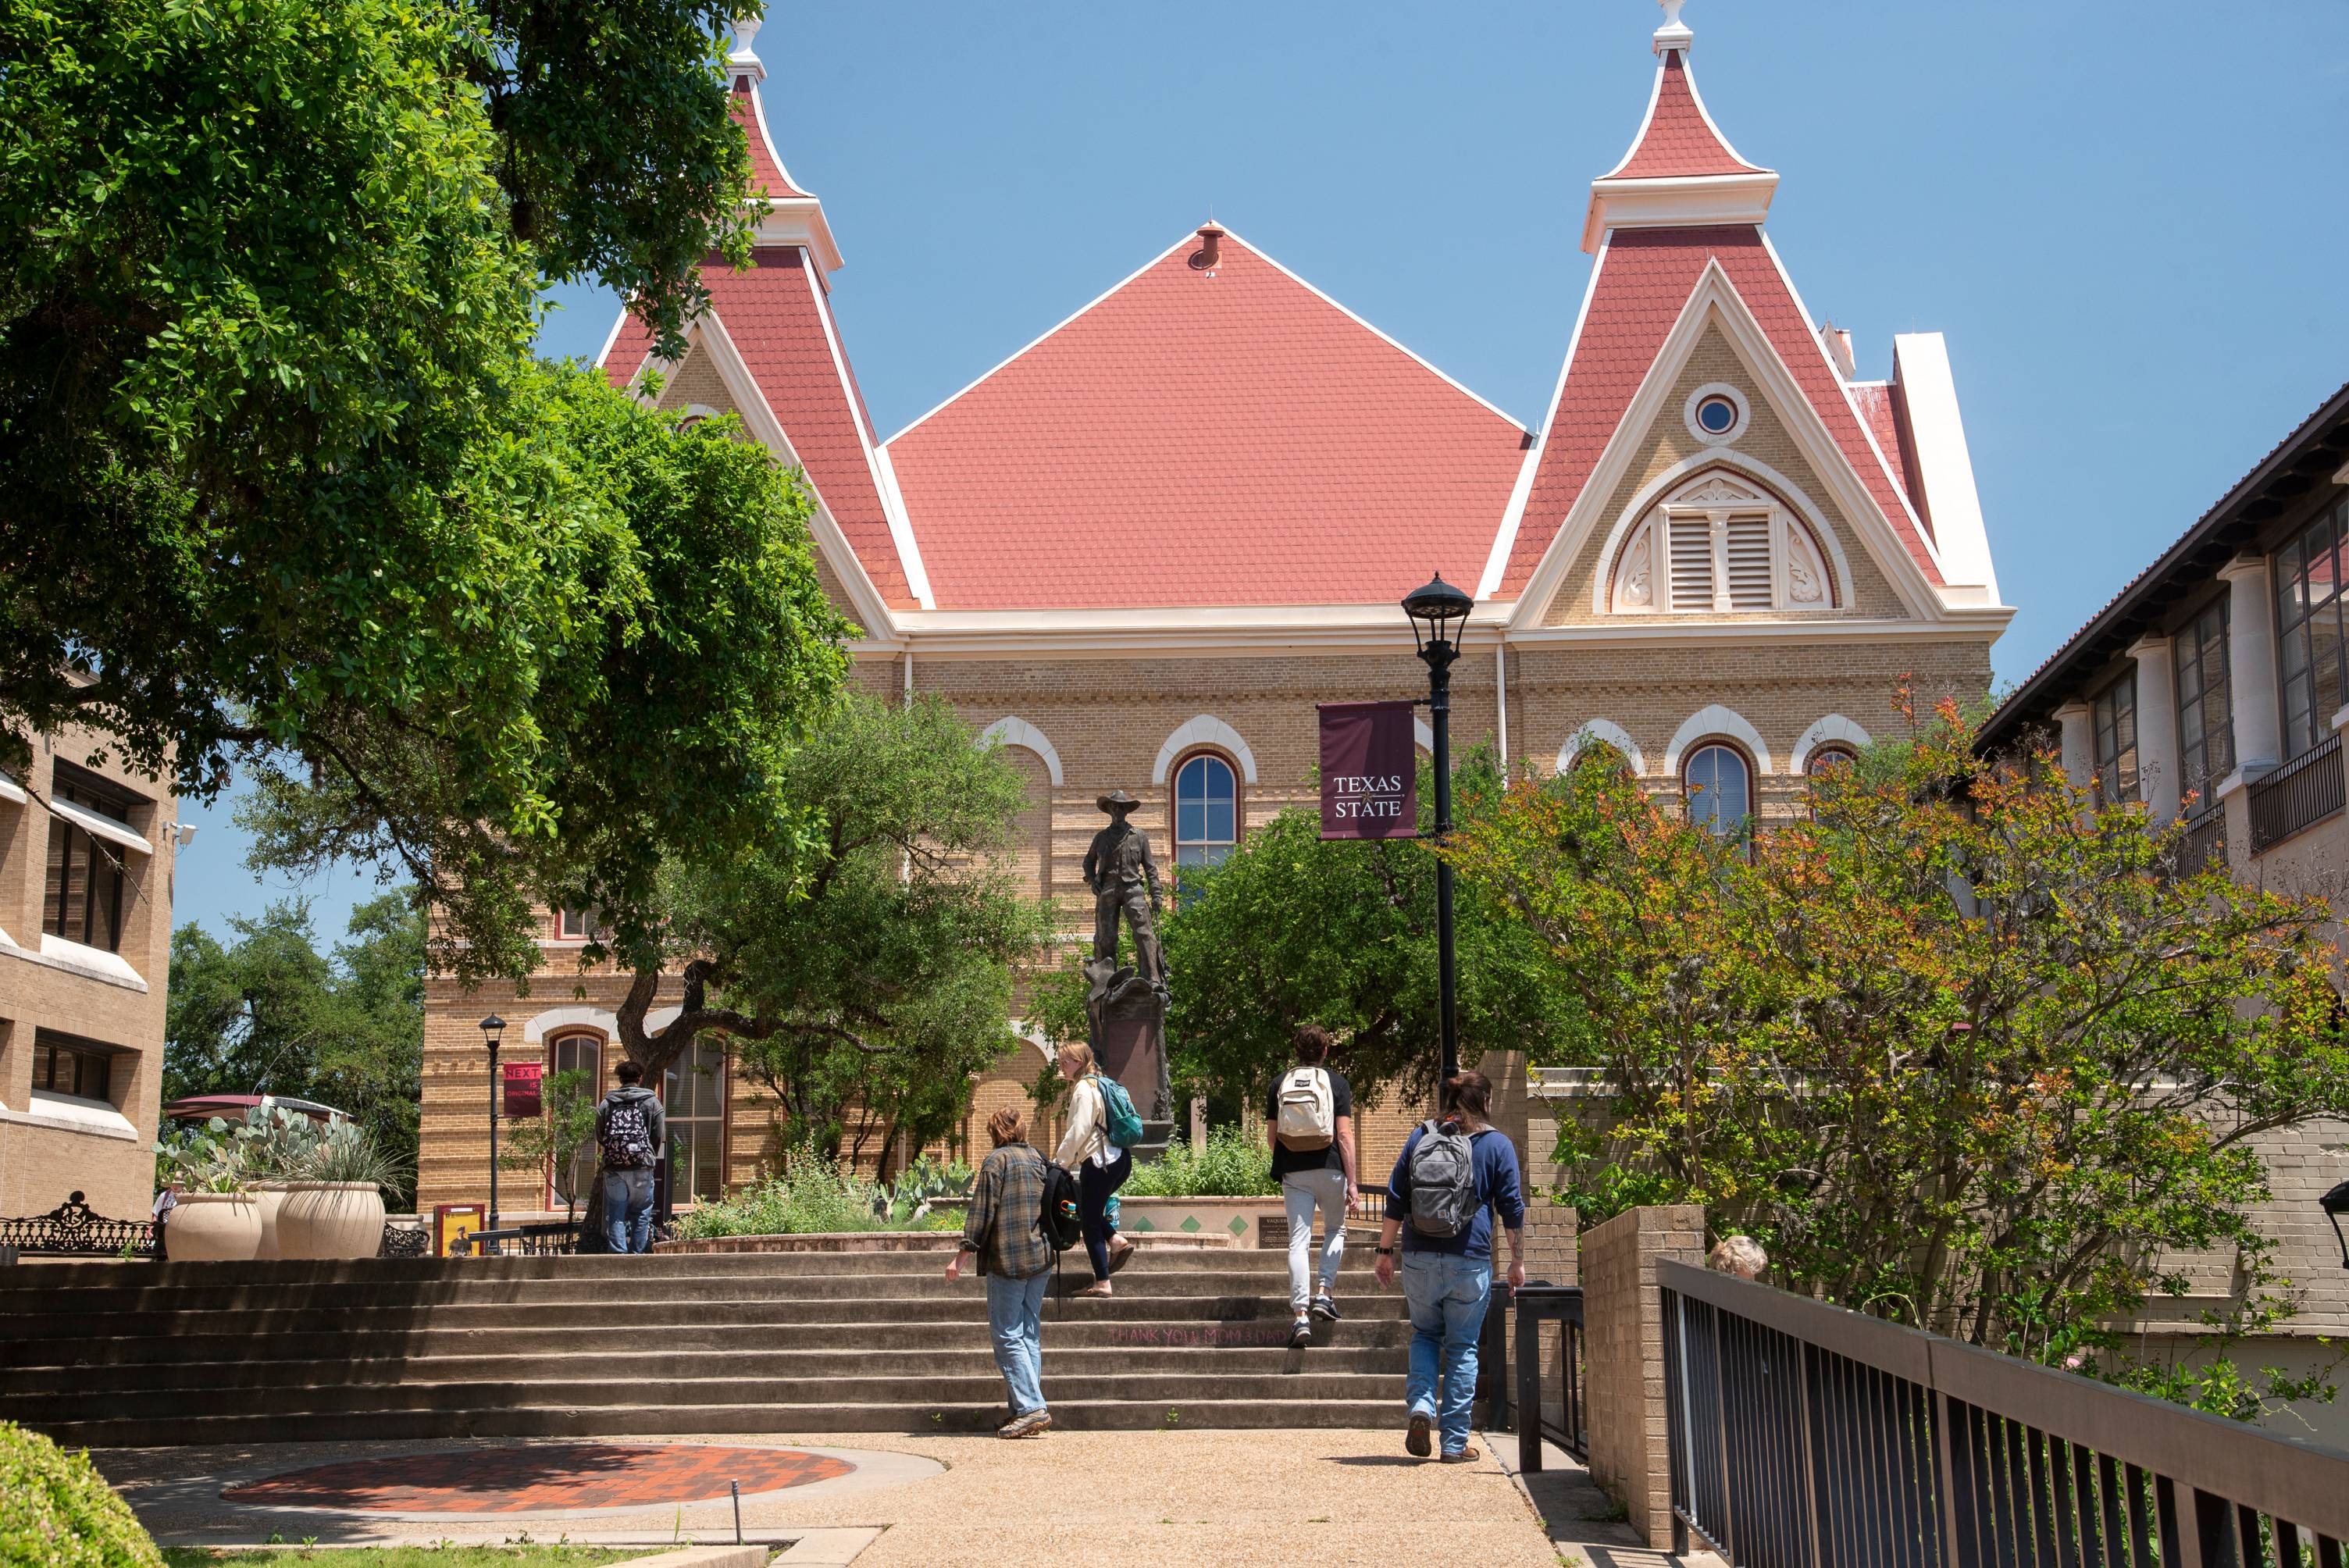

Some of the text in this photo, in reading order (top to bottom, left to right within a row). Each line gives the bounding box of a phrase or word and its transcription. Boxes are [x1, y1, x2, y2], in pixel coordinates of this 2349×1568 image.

[1334, 775, 1402, 793] TEXAS
[1335, 801, 1402, 818] STATE
[505, 1068, 539, 1078] NEXT
[1110, 1327, 1160, 1344] THANK
[1204, 1329, 1241, 1344] MOM
[1256, 1330, 1287, 1344] DAD
